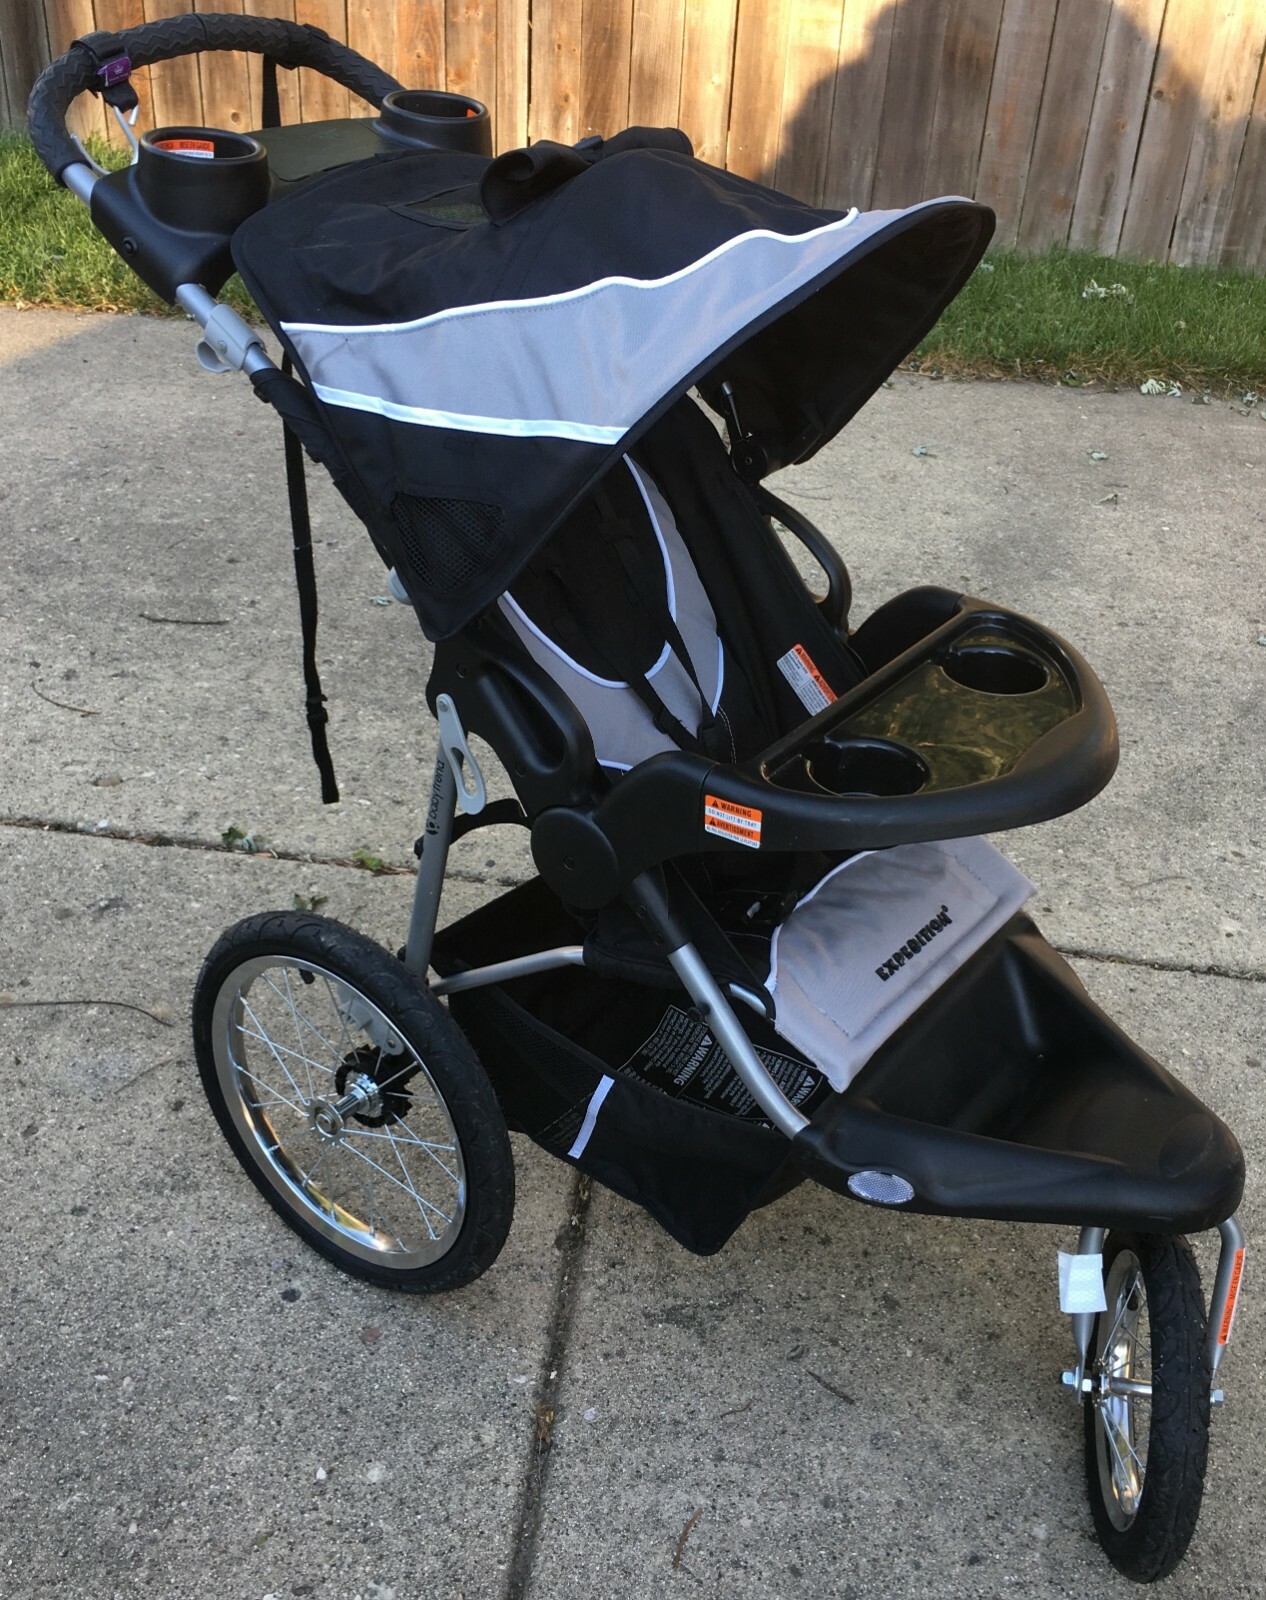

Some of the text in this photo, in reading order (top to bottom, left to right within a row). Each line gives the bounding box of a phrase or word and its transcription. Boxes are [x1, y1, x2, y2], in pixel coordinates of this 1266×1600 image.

[720, 801, 752, 817] WARNING
[737, 816, 743, 824] BY
[744, 818, 757, 828] TRAY
[875, 908, 952, 982] EXPEDITION
[674, 1046, 709, 1086] WARNING
[1223, 1304, 1233, 1332] WARNING
[1229, 1283, 1238, 1299] MISE
[1235, 1255, 1243, 1274] GARDE
